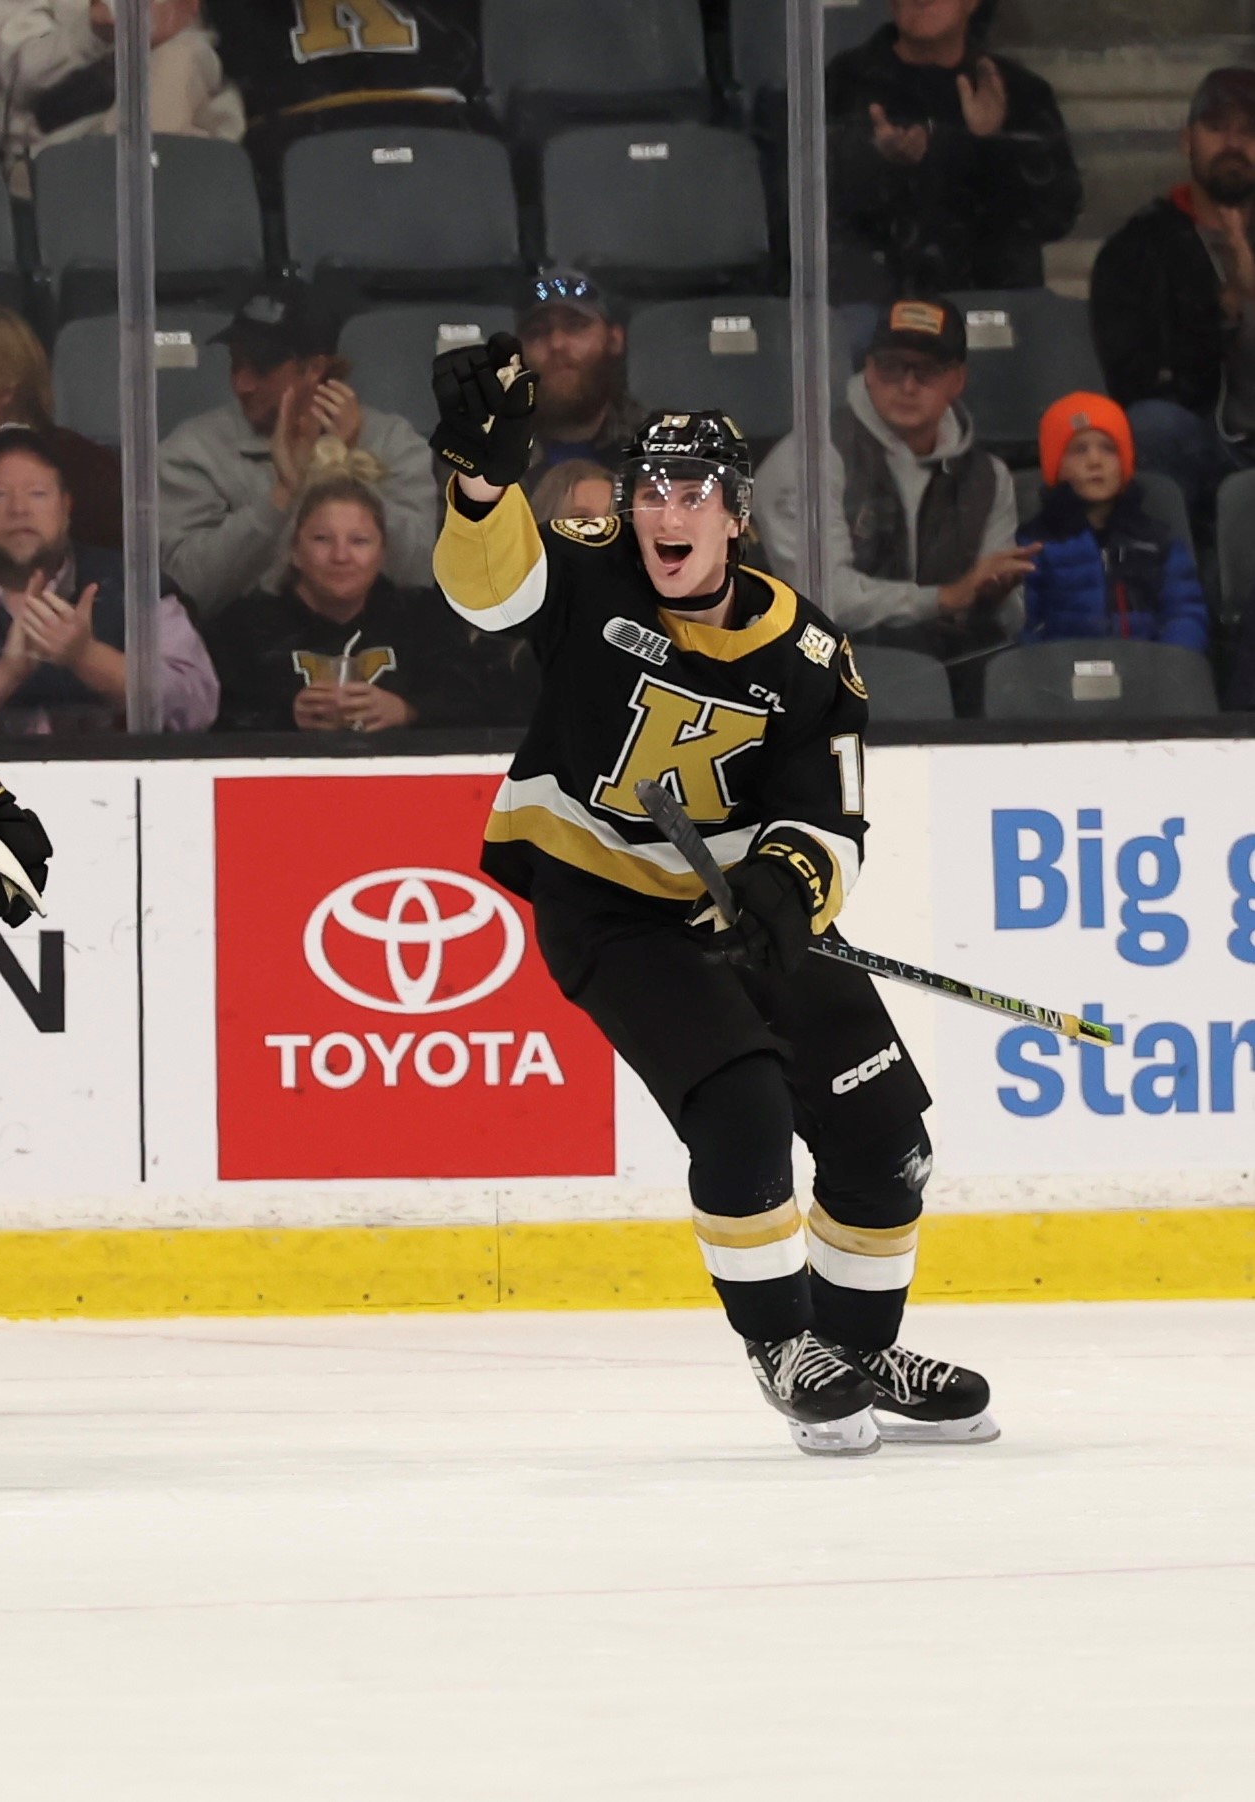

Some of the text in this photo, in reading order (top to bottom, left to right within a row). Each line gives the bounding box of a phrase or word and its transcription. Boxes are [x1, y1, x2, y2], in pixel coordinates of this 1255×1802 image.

[441, 448, 475, 470] CCM
[649, 443, 692, 452] CCM
[803, 625, 835, 660] 50
[591, 672, 769, 823] K
[757, 842, 825, 909] CCM
[992, 809, 1189, 967] Big
[264, 1031, 565, 1089] TOYOTA
[832, 1041, 902, 1095] CCM
